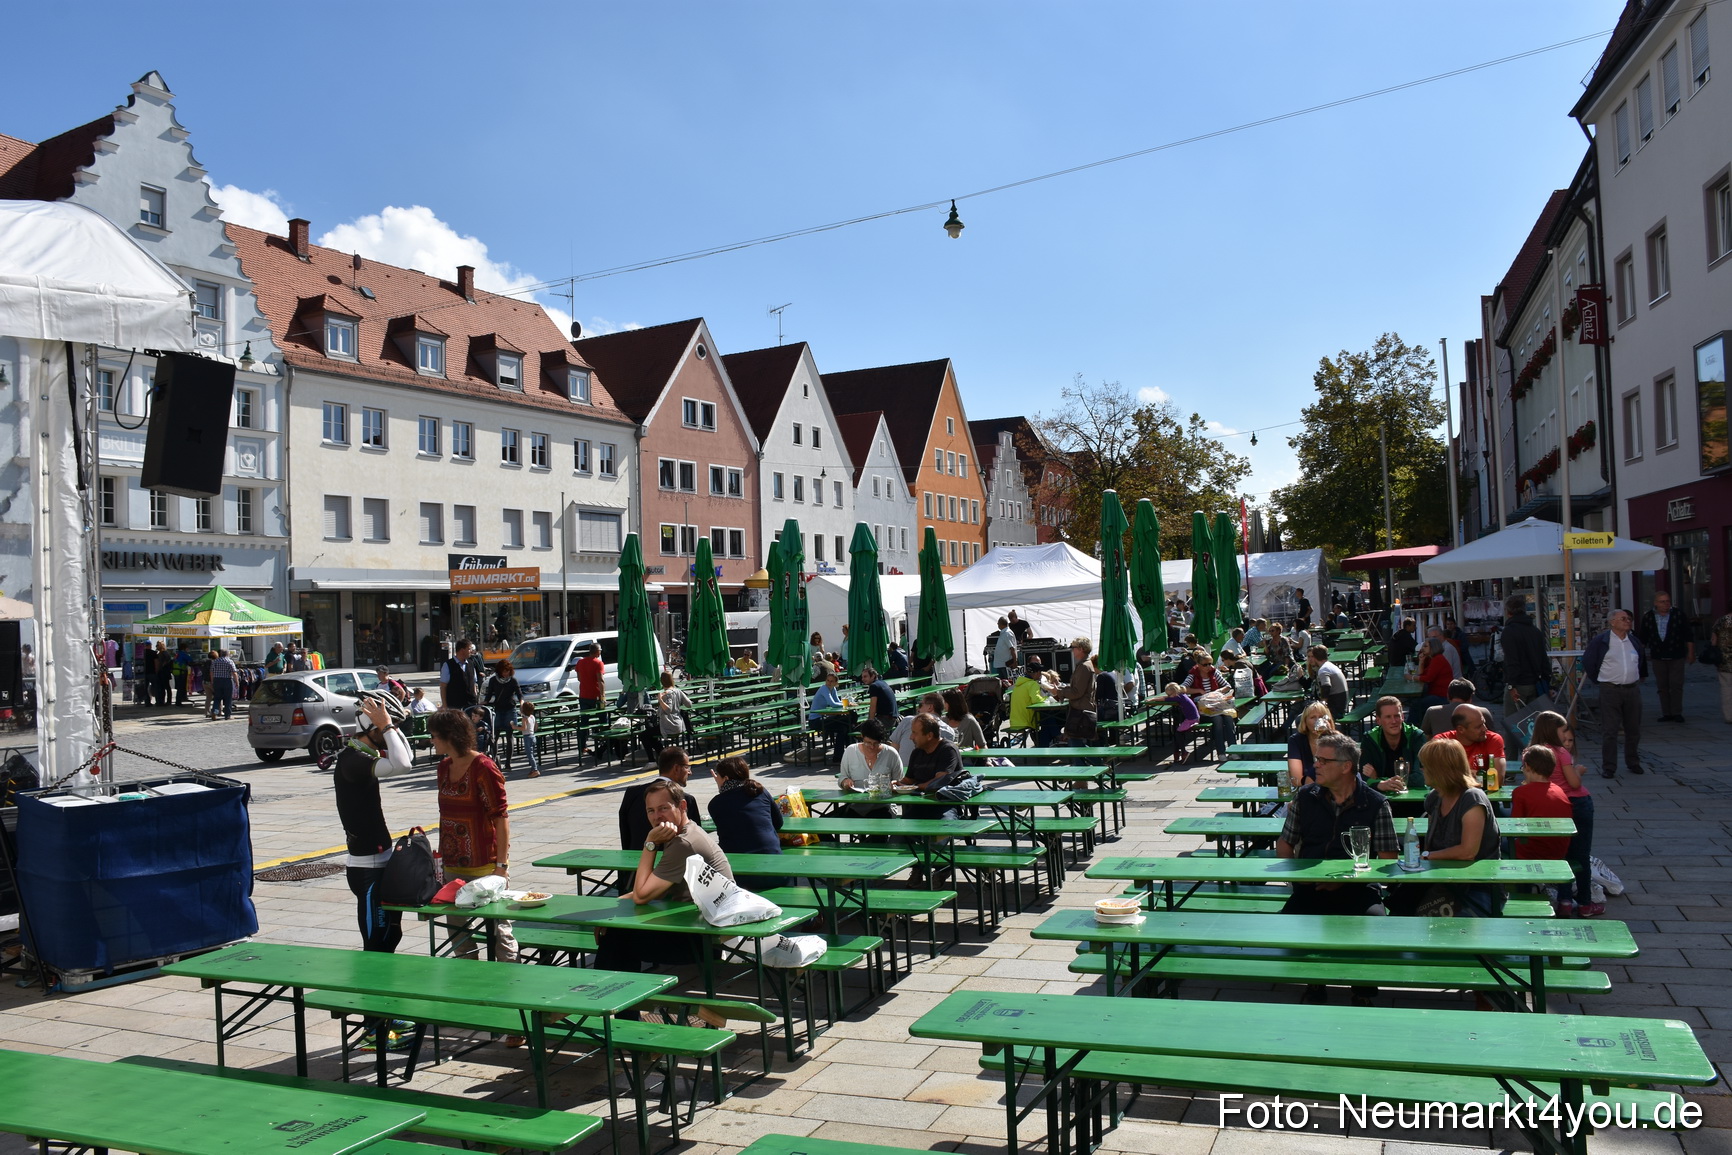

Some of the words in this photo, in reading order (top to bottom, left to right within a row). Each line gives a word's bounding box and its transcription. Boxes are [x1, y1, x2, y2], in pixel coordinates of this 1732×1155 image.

[1582, 298, 1598, 340] Achatz
[1667, 497, 1694, 522] Achatz
[1572, 537, 1604, 545] Toiletten
[101, 551, 160, 570] RILLEN
[161, 552, 225, 572] WEBER
